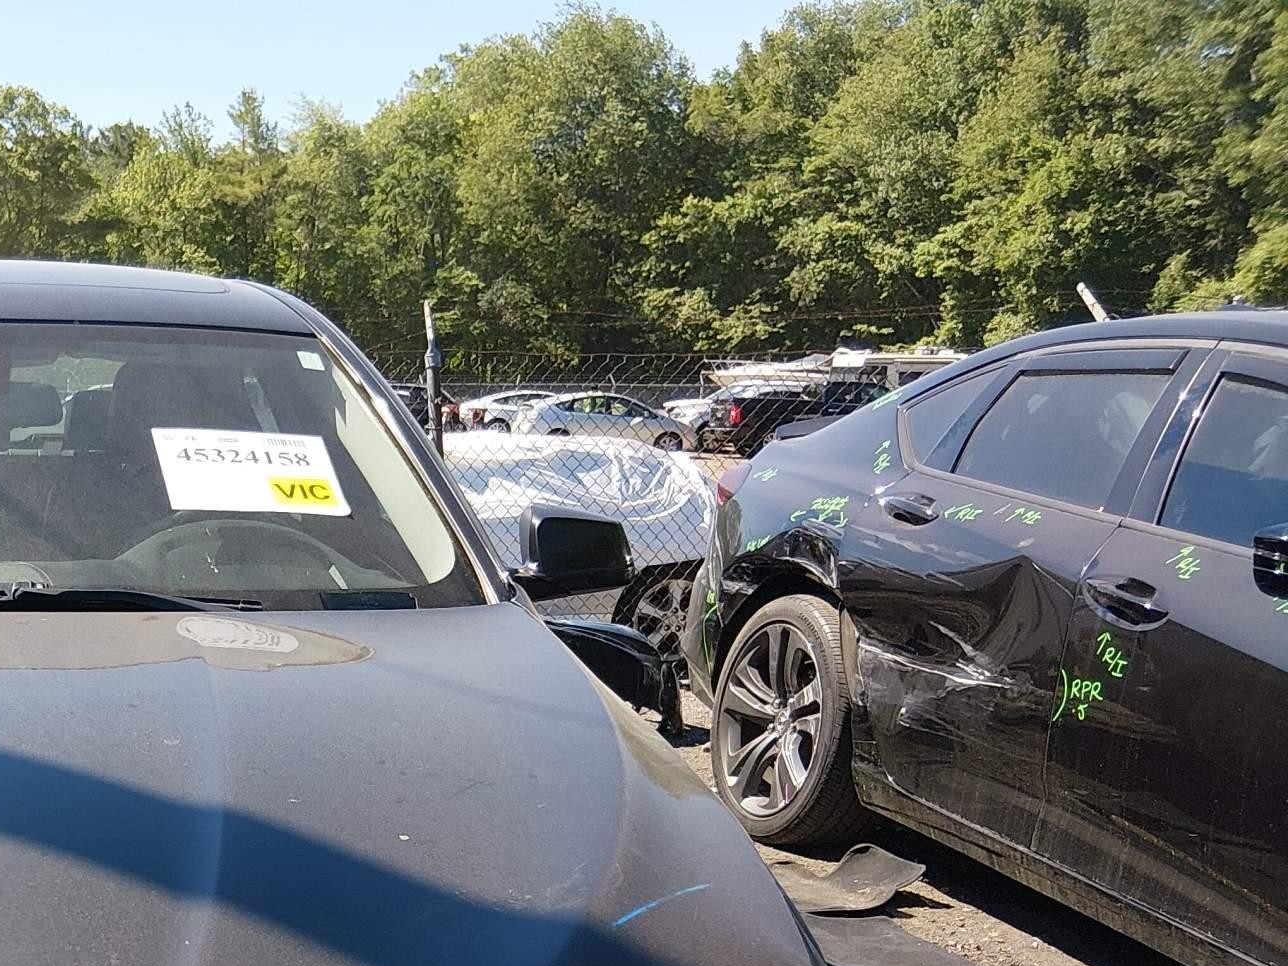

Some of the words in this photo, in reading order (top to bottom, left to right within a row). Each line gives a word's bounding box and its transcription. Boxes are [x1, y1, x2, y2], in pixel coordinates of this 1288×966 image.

[176, 447, 311, 467] 45324158
[273, 483, 331, 501] VIC
[1101, 646, 1129, 678] R/I
[1069, 678, 1104, 702] RPR
